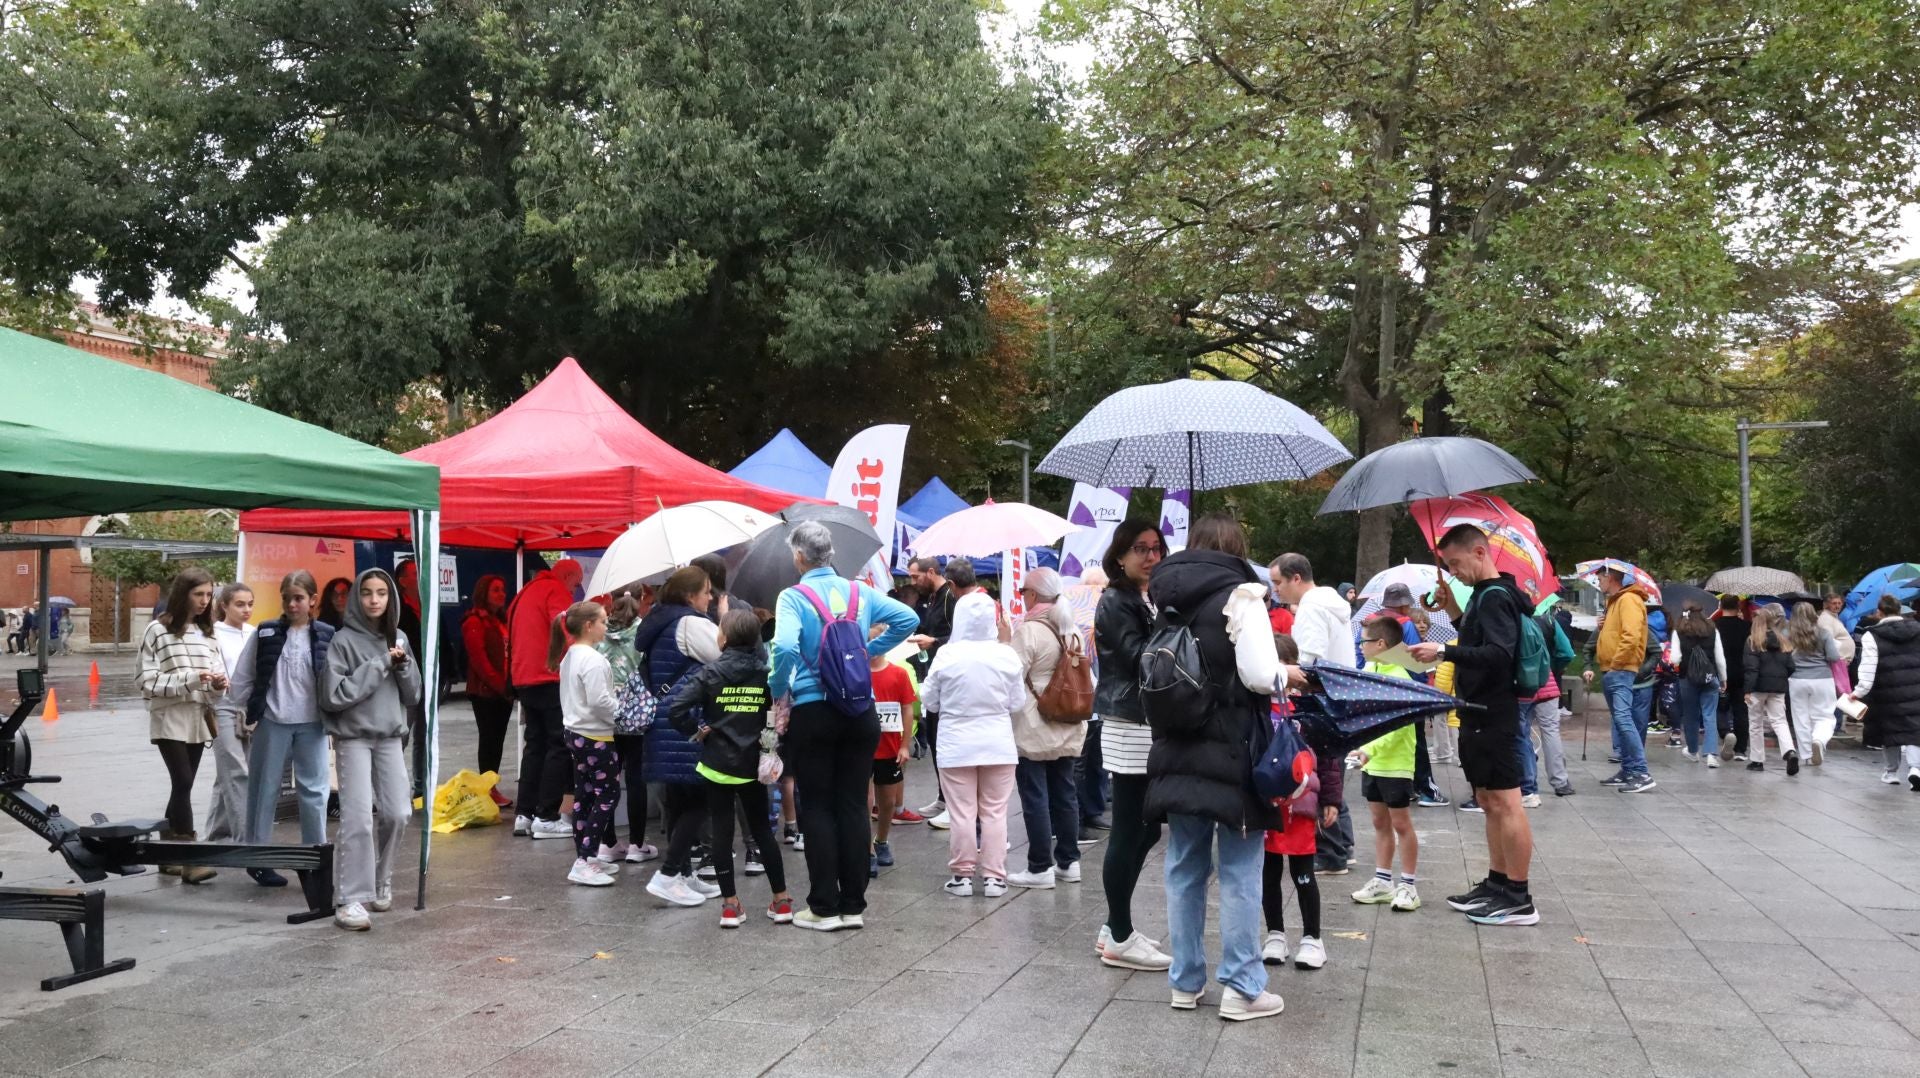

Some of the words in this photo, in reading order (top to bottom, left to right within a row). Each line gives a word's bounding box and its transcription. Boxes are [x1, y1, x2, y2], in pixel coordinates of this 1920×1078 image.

[251, 543, 297, 560] ARPA
[723, 705, 760, 713] PALENCIA
[877, 713, 898, 723] 277
